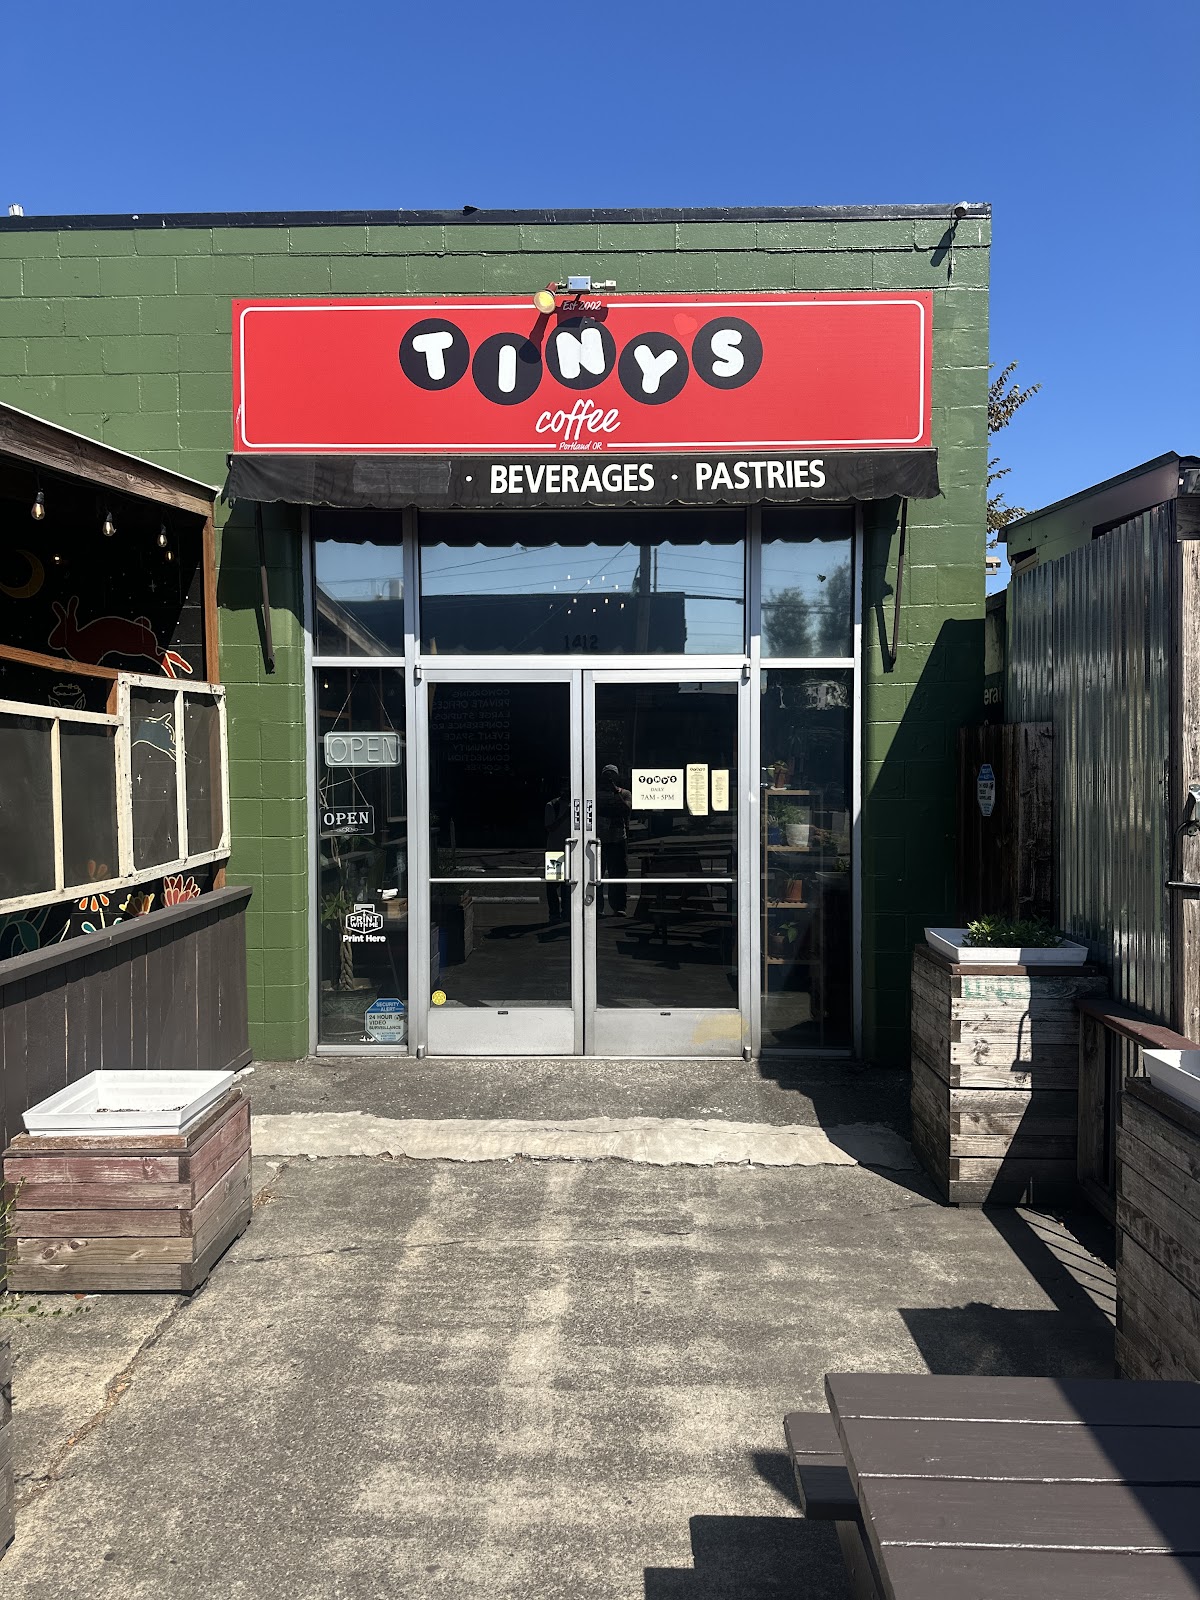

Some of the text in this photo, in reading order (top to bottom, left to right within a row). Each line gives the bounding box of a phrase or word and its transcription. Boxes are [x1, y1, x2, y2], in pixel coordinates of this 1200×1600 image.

[562, 300, 602, 311] Est 2002
[535, 399, 621, 440] coffee
[559, 440, 603, 450] Portland OR
[489, 459, 827, 495] BEVERAGES PASTRIES
[564, 634, 598, 650] 1412
[329, 736, 397, 762] OPEN
[323, 811, 369, 826] OPEN
[350, 915, 379, 923] PRINT
